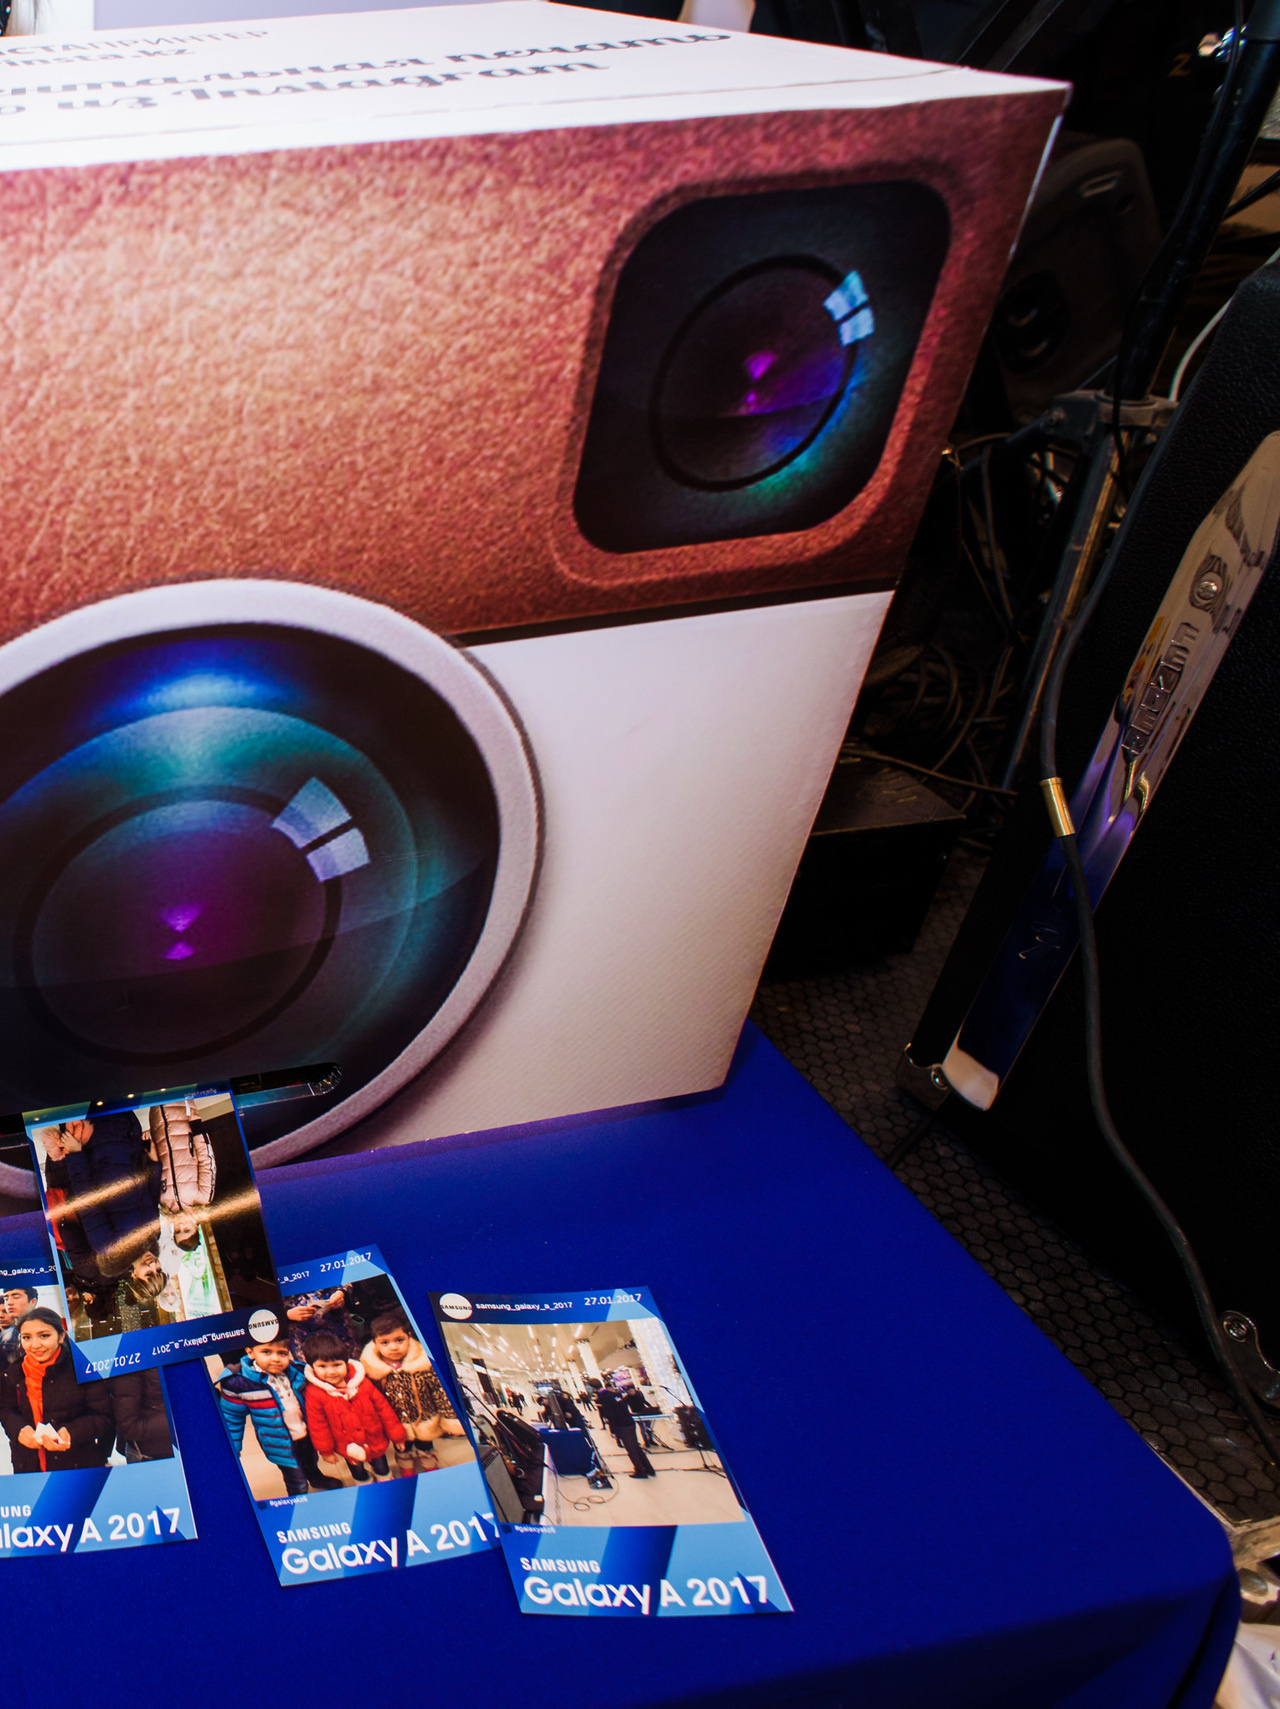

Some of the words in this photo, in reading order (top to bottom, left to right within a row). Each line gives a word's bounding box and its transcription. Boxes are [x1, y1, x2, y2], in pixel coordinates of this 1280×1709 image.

[445, 33, 732, 64] печать
[57, 96, 158, 110] из
[172, 63, 609, 102] Instagram
[320, 1252, 372, 1273] 27.01.2017
[475, 1301, 573, 1312] samsung_galaxy_a_2017
[584, 1293, 642, 1306] 27.01.2017
[152, 1328, 246, 1356] samsung_galaxy_a_2017
[85, 1352, 141, 1374] 27.01.2017
[79, 1517, 103, 1544] A
[108, 1507, 180, 1541] 2017
[276, 1521, 352, 1544] SAMSUNG
[281, 1537, 399, 1575] Galaxy
[406, 1529, 431, 1557] A
[429, 1512, 500, 1551] 2017
[520, 1557, 602, 1574] SAMSUNG
[523, 1576, 651, 1616] Galaxy
[659, 1578, 687, 1608] A
[686, 1575, 768, 1607] 2017
